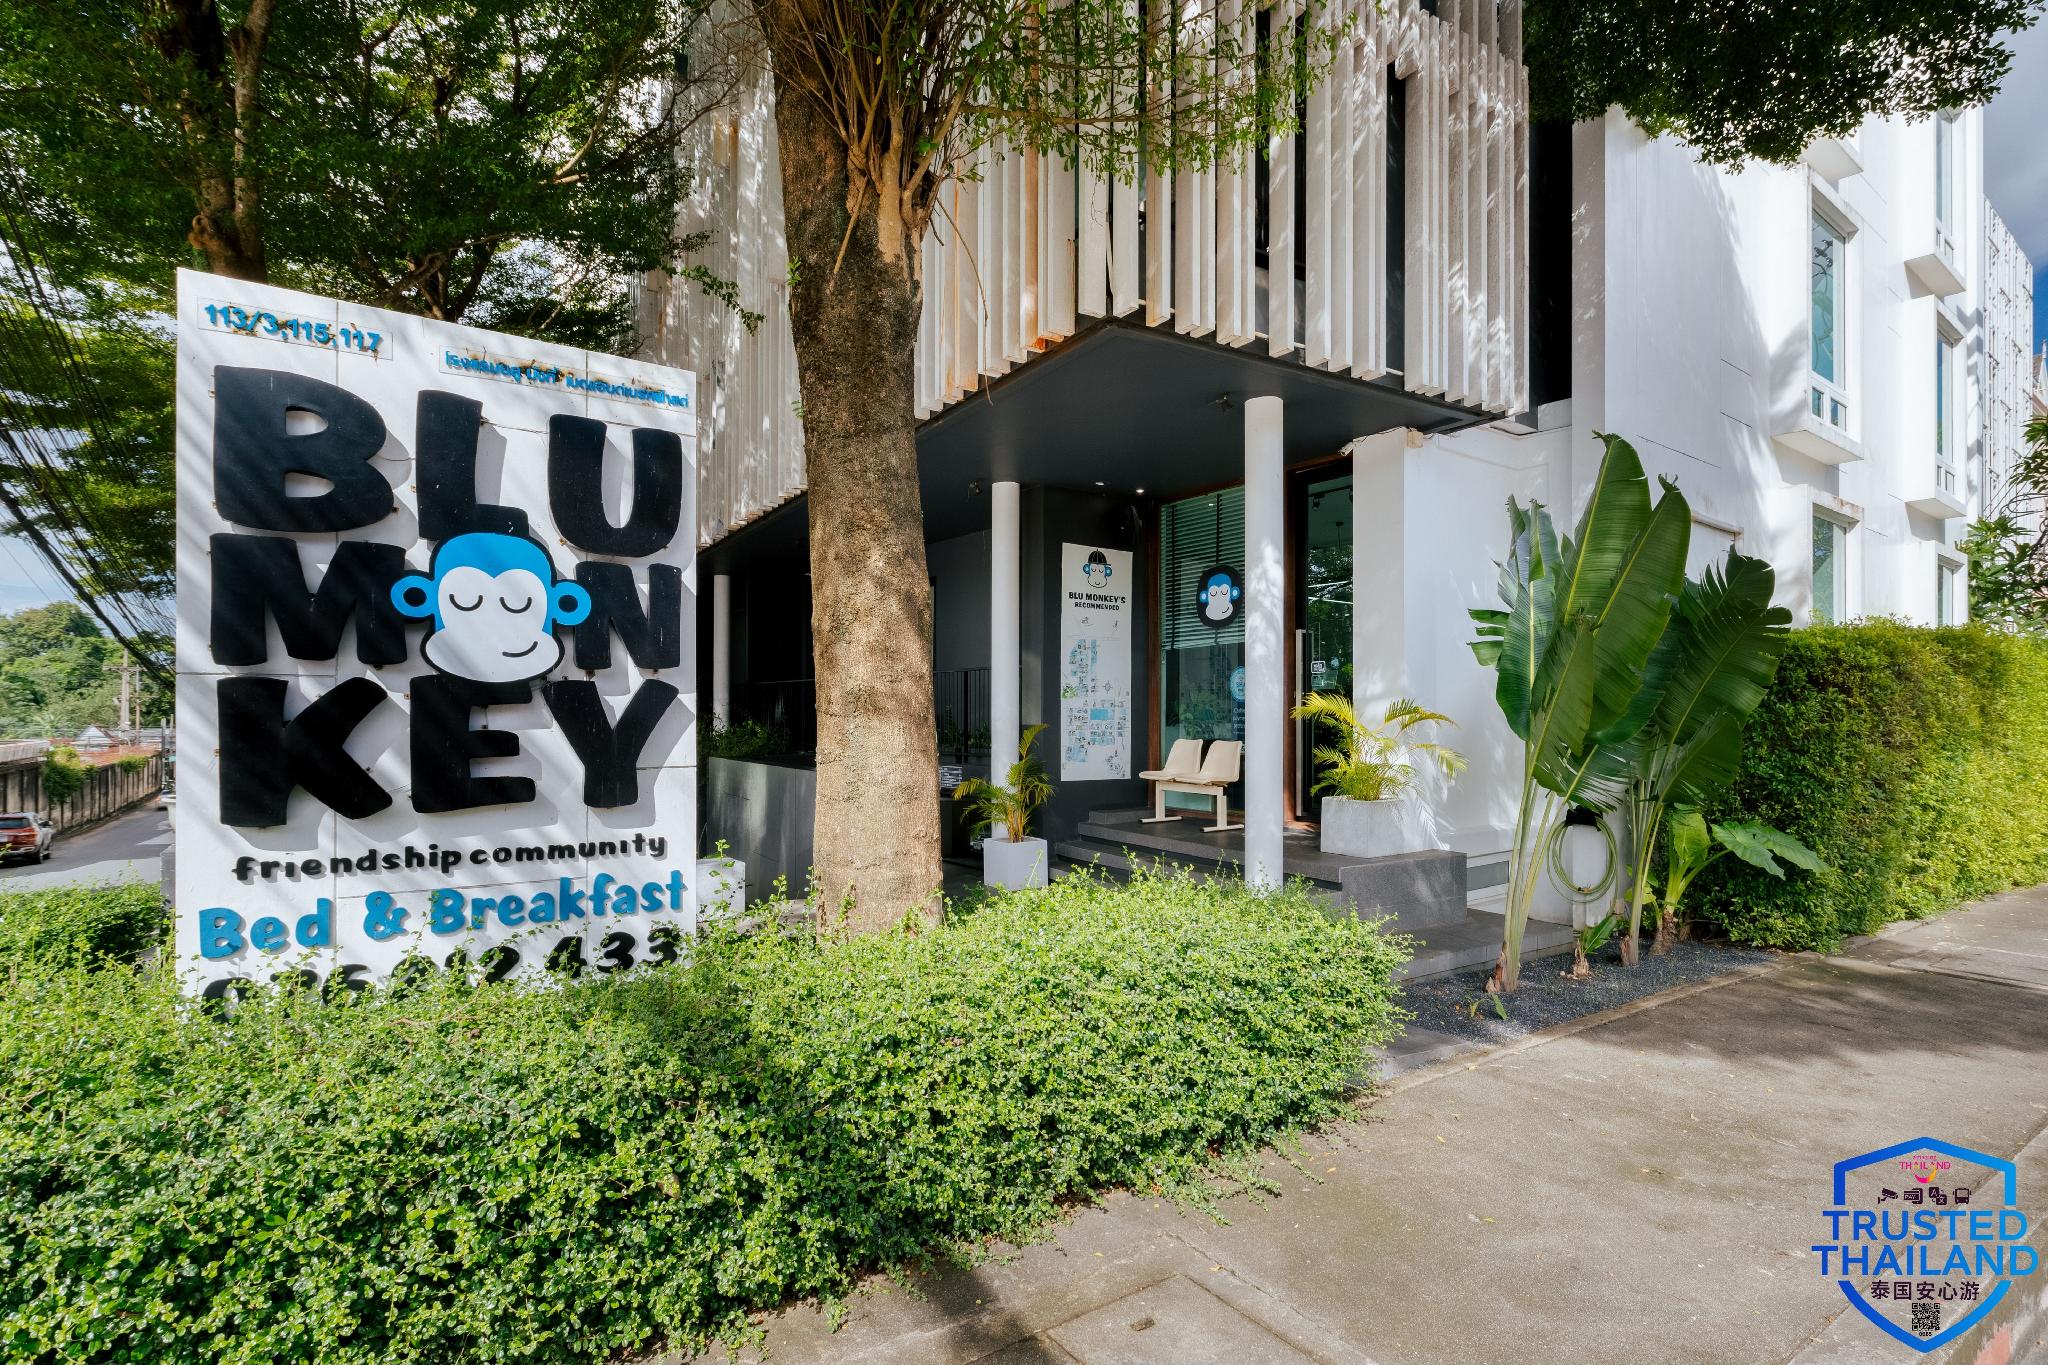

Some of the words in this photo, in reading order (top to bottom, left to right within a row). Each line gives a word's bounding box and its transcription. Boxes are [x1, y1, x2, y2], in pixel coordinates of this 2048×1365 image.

[213, 365, 683, 557] BLU
[1069, 592, 1083, 600] BLU
[1086, 593, 1126, 603] MONKEY'S
[1075, 602, 1120, 611] RECOMMENDED
[216, 675, 680, 828] KEY
[233, 843, 462, 881] friendship
[470, 832, 667, 864] community
[199, 897, 334, 959] Bed
[364, 889, 408, 941] &
[430, 869, 687, 935] Breakfast
[546, 927, 682, 979] 433
